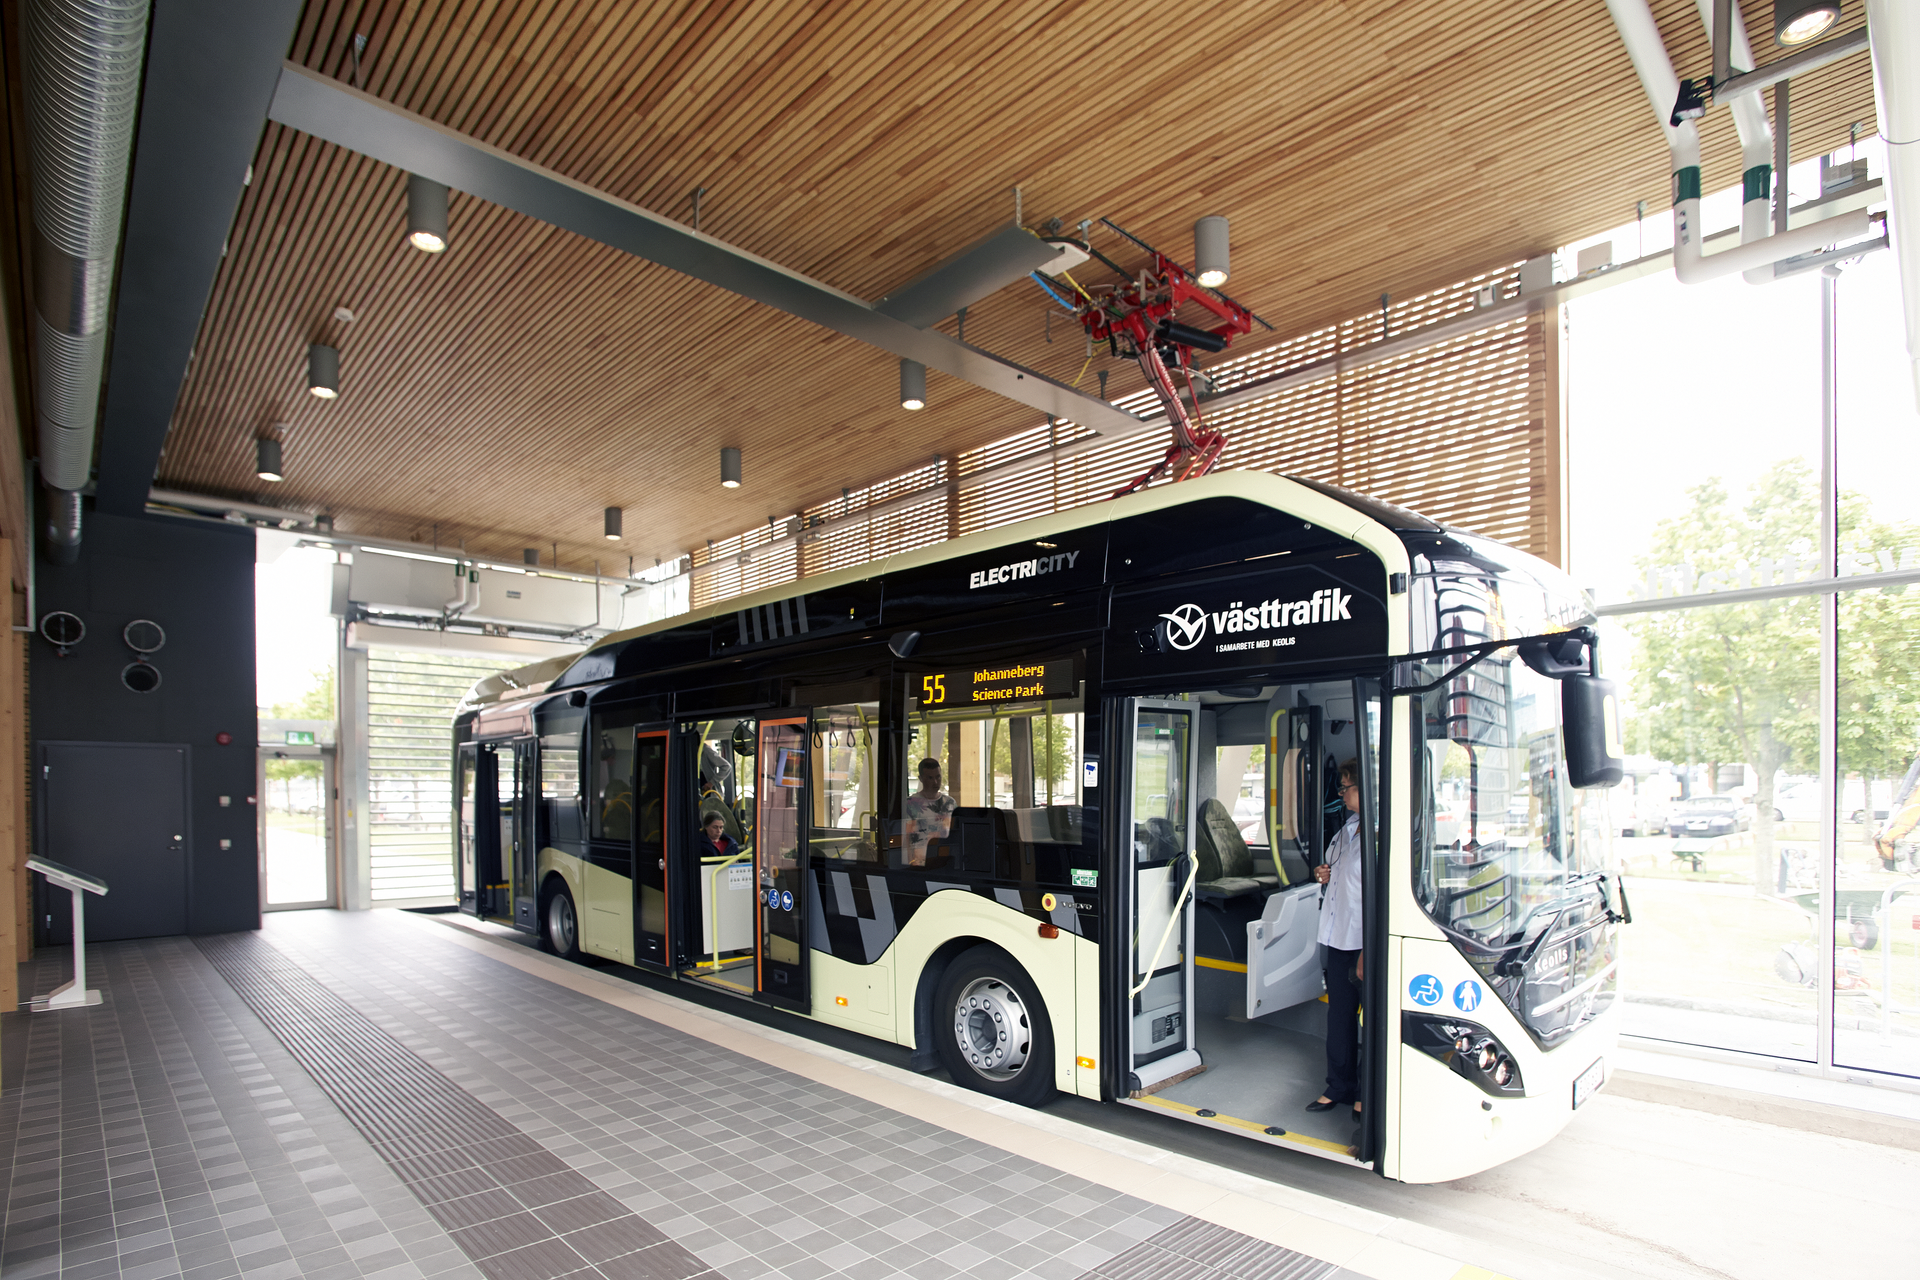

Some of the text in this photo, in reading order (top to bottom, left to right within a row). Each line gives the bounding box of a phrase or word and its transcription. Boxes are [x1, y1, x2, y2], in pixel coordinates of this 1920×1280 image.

[969, 550, 1080, 589] ELECTRICITY
[1212, 587, 1352, 635] västtrafik
[1215, 636, 1296, 653] I SAMARBETE MED KEOLIS
[973, 665, 1045, 684] Johanneberg
[923, 674, 945, 704] 55
[972, 683, 1044, 701] Science Park
[1061, 901, 1093, 911] VOLVO
